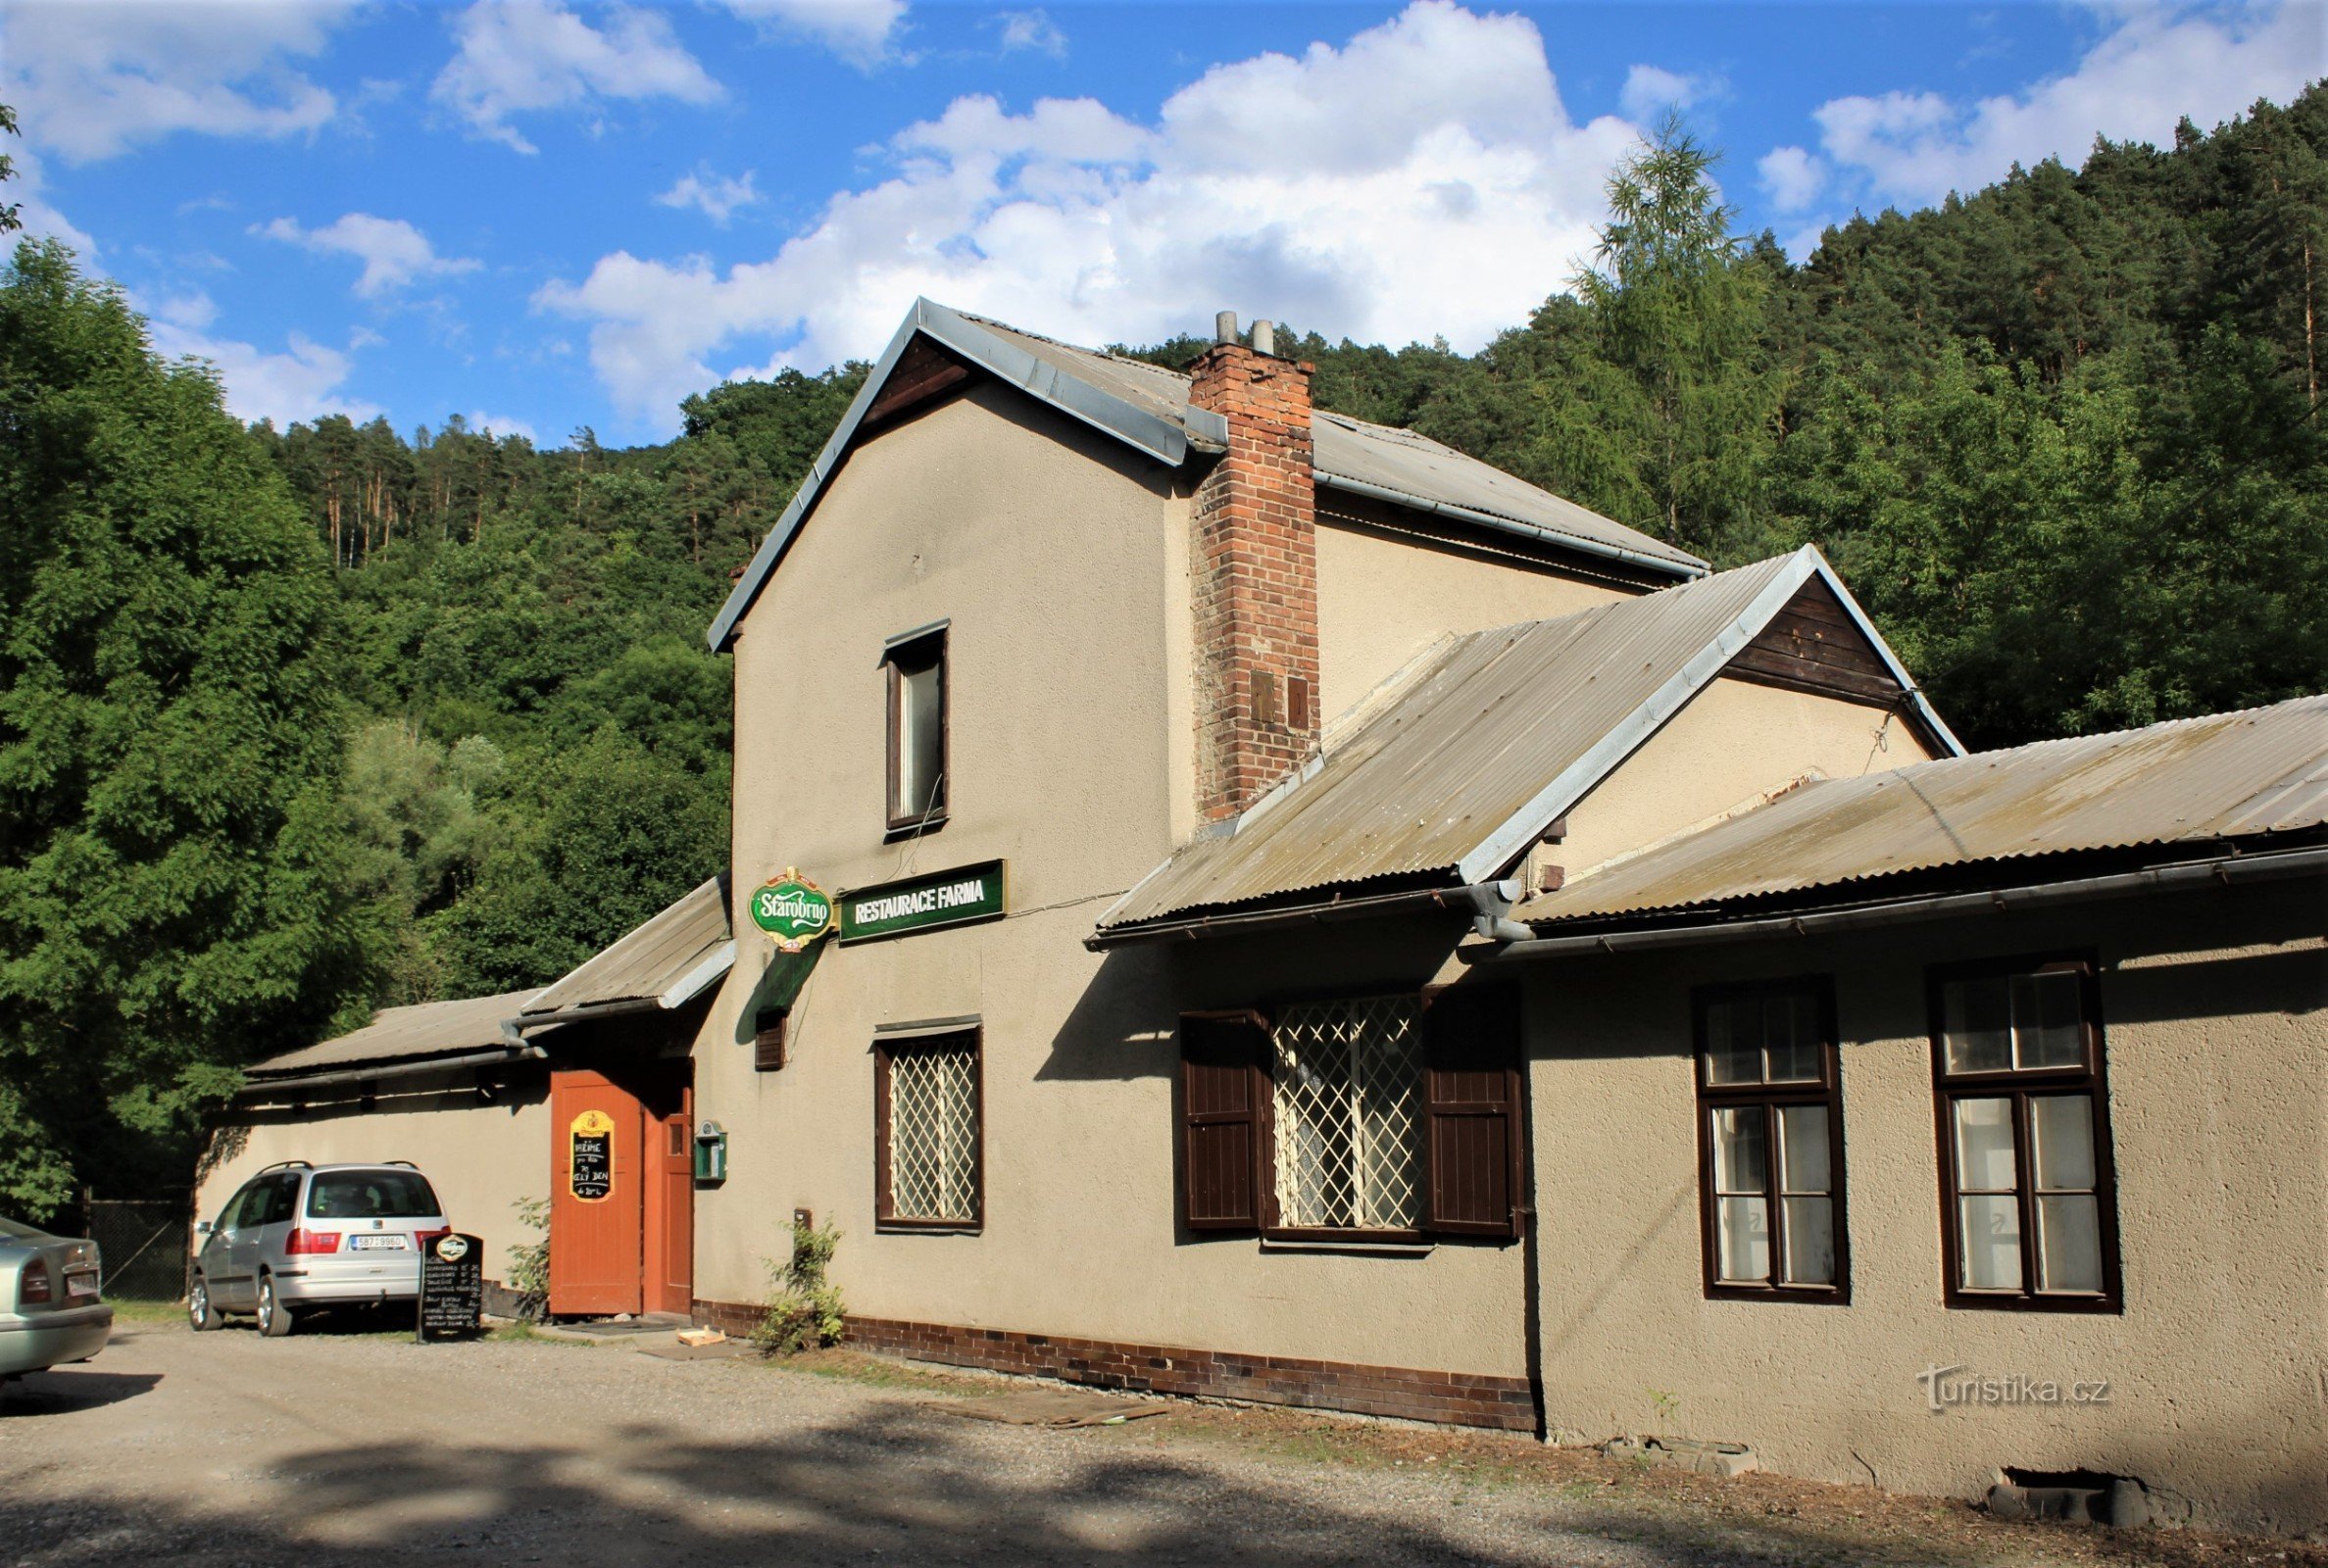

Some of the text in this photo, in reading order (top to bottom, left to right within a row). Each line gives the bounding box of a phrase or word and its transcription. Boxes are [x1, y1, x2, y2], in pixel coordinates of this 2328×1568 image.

[761, 890, 827, 929] Starobrno
[855, 879, 984, 924] RESTAURACE FARMA
